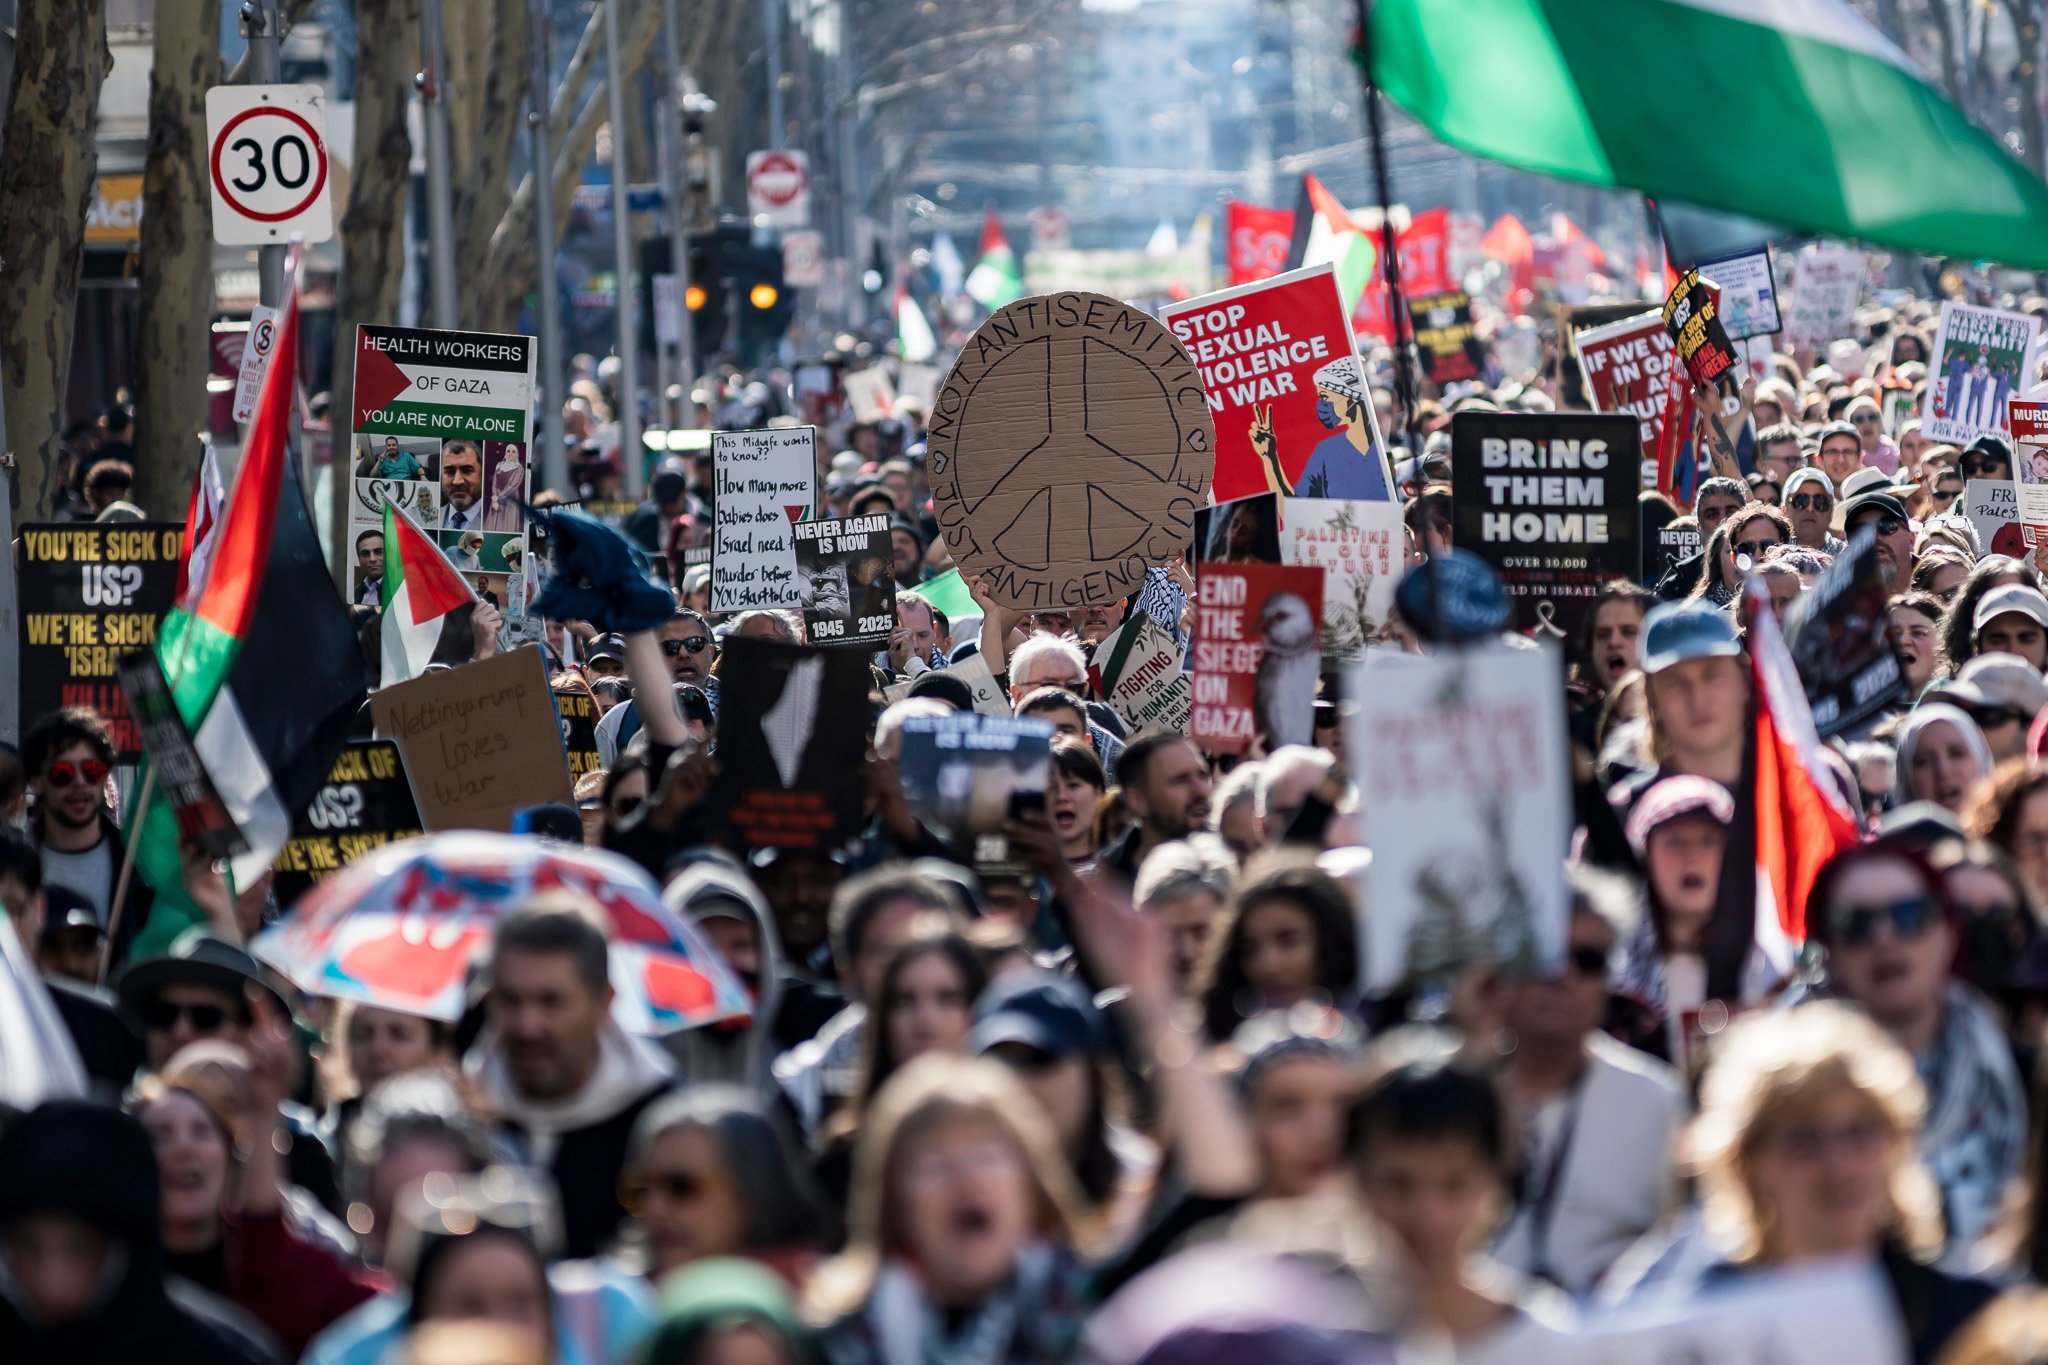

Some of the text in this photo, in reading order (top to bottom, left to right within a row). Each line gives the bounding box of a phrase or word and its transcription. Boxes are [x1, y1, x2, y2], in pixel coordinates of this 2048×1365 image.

[231, 135, 310, 192] 30
[1172, 304, 1245, 341] STOP
[1949, 316, 1998, 333] MARCH
[364, 336, 522, 361] HEALTH WORKERS
[978, 295, 1205, 406] ANTISEMITIC
[1185, 320, 1290, 365] SEXUAL
[1948, 325, 2026, 352] HUMANITY
[1586, 350, 1607, 373] IF
[1610, 338, 1650, 365] WE
[416, 376, 490, 394] OF GAZA
[1613, 362, 1641, 386] IN
[932, 362, 970, 440] NOT
[1205, 371, 1297, 412] N WAR
[362, 409, 516, 432] YOU ARE NOT ALONE
[2014, 409, 2048, 421] MURD
[715, 436, 737, 448] This
[783, 437, 811, 447] wants
[717, 452, 728, 462] to
[1481, 438, 1609, 469] BRING
[716, 468, 808, 500] How many more
[1484, 476, 1604, 506] THEM
[716, 501, 779, 525] babies does
[795, 515, 888, 540] NEVER AGAIN
[1482, 512, 1609, 543] HOME
[23, 531, 100, 561] YOU'RE
[106, 531, 157, 561] SICK
[715, 527, 753, 557] Israel
[757, 535, 782, 551] need
[818, 534, 868, 554] IS NOW
[1296, 528, 1389, 544] PALESTINE
[1660, 531, 1700, 545] NEVER
[1340, 545, 1389, 558] OUR
[1503, 556, 1541, 569] OVER
[1680, 546, 1692, 558] IS
[82, 564, 142, 606] US?
[761, 565, 792, 584] before
[1200, 575, 1247, 606] END
[1502, 585, 1599, 596] ELD IN ISRAEL
[26, 614, 156, 645] WE'RE SICK
[812, 614, 893, 637] 1945 2025
[1200, 609, 1244, 640] THE
[1196, 641, 1263, 674] SIEGE
[1116, 651, 1172, 701] FIGHTING
[1145, 680, 1166, 698] FOR
[1195, 674, 1229, 704] ON
[1139, 673, 1193, 722] HUMANITY
[1159, 700, 1184, 724] IS NOT
[1183, 695, 1192, 705] A
[1195, 707, 1255, 737] GAZA
[368, 747, 396, 780] OF
[308, 786, 363, 830] US?
